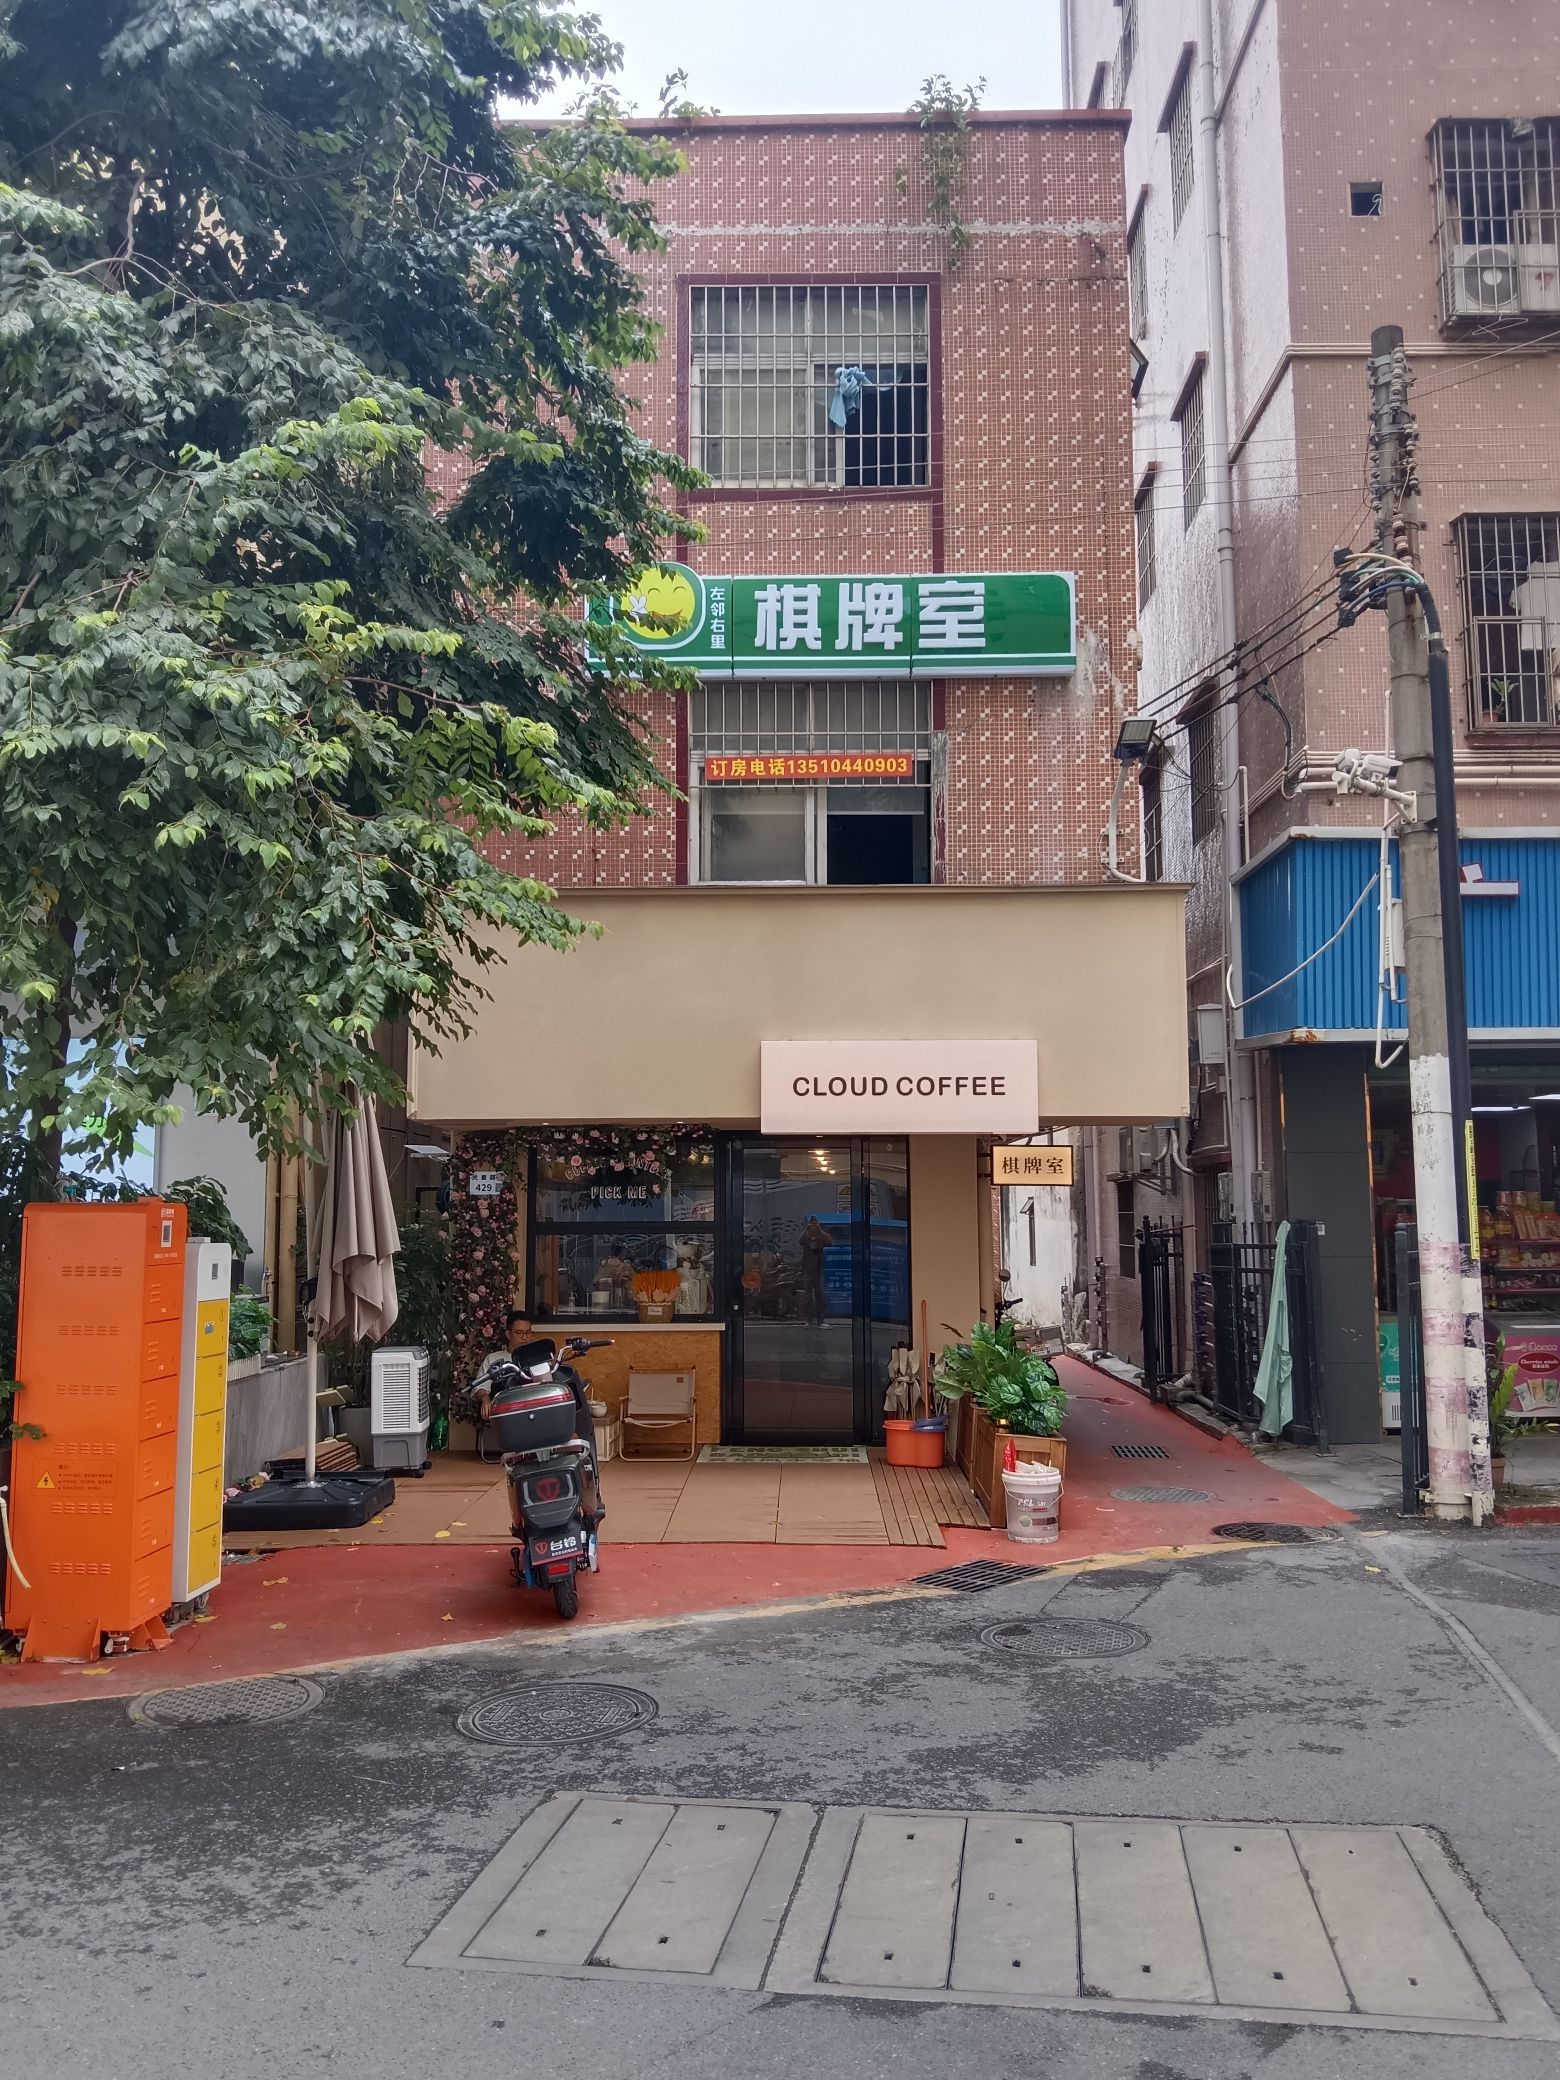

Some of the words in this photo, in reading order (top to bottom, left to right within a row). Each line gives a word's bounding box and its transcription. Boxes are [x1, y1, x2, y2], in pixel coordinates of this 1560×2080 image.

[710, 587, 726, 650] 左邻右里
[754, 580, 987, 651] 棋牌室
[711, 757, 908, 777] 订房电话13510440903
[792, 1076, 888, 1097] CLOUD
[896, 1076, 1006, 1097] COFFEE
[1002, 1156, 1064, 1175] 棋牌室
[475, 1183, 492, 1192] 429
[591, 1186, 622, 1199] PICK
[627, 1186, 647, 1199] ME
